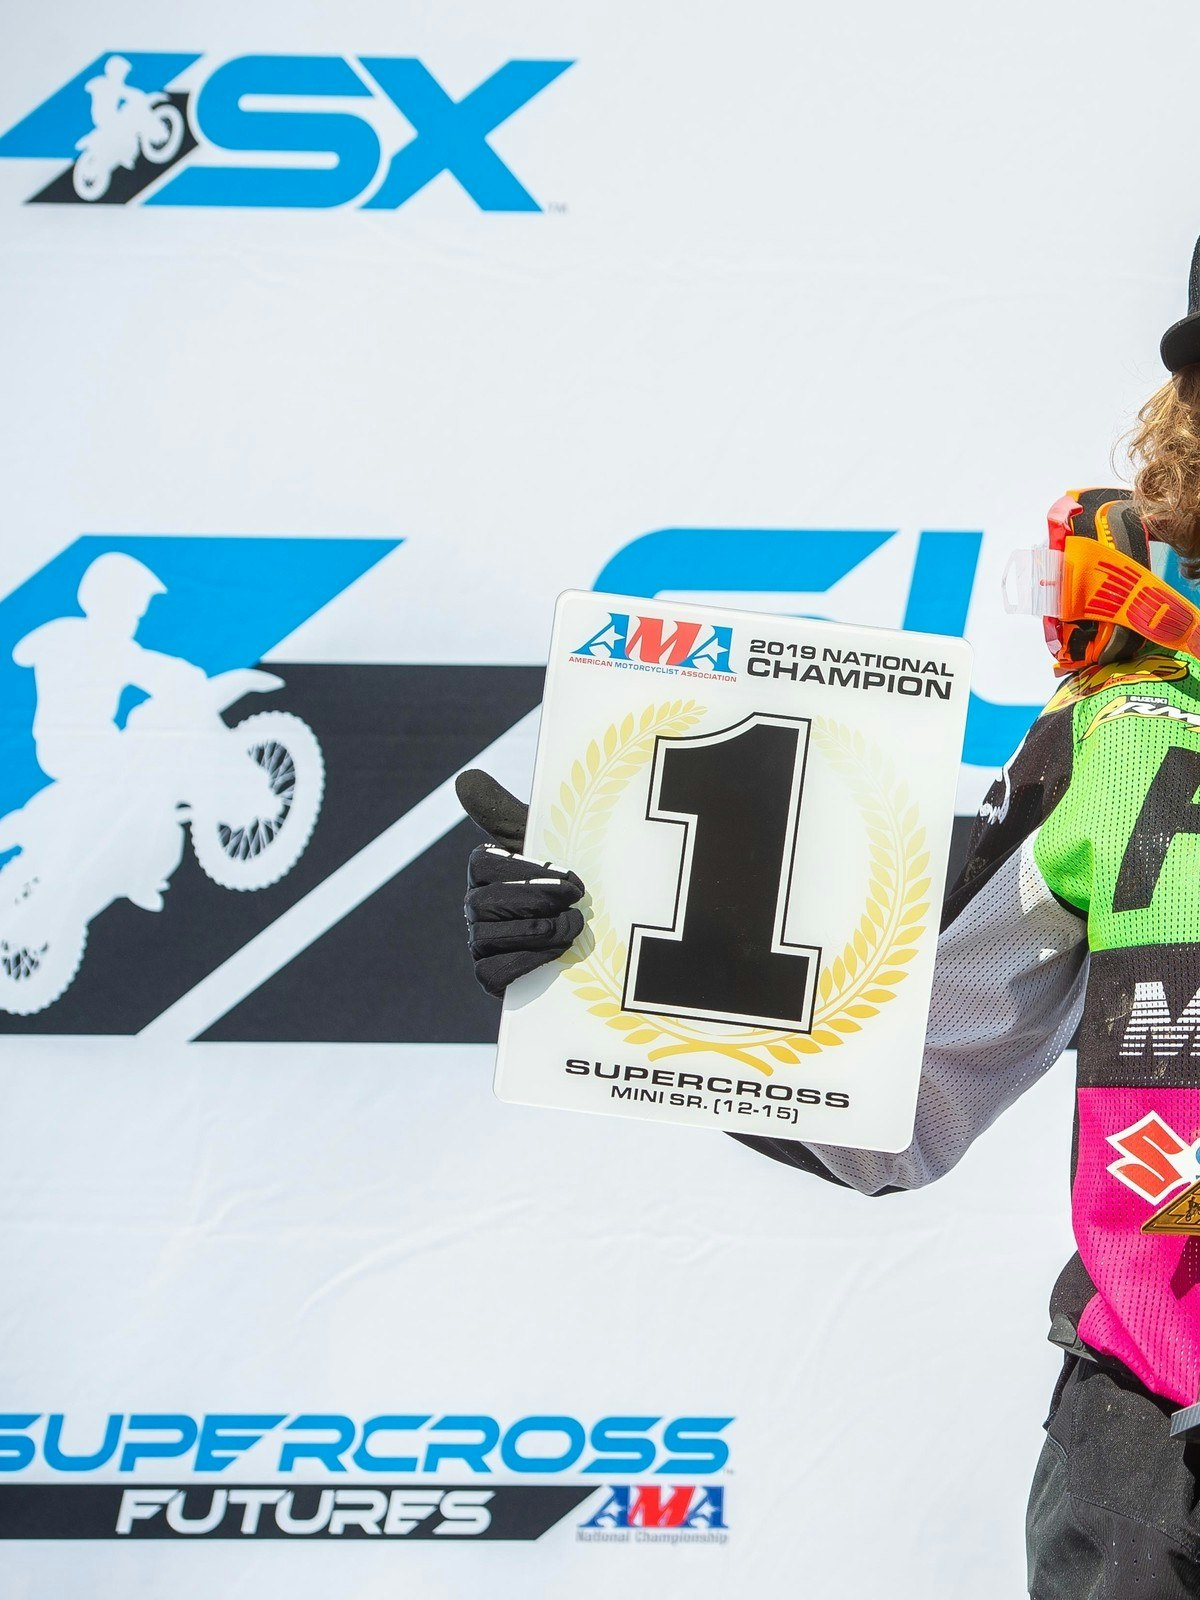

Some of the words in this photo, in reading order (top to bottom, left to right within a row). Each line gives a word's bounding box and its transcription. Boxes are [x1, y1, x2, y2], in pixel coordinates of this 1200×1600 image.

[569, 612, 738, 674] AMA
[750, 639, 816, 660] 2019
[822, 648, 954, 677] NATIONAL
[568, 656, 613, 667] AMERICAN
[614, 661, 680, 675] MOTORCYCLIST
[680, 670, 738, 682] ASSOCIATION
[747, 657, 952, 700] CHAMPION
[1130, 695, 1168, 705] SUZUKI
[621, 711, 822, 1034] 1
[565, 1058, 850, 1109] SUPERCROSS
[611, 1085, 664, 1103] MINI
[669, 1094, 708, 1110] SR.
[116, 1489, 496, 1536] FUTURES
[579, 1486, 728, 1528] AMA
[576, 1531, 629, 1543] National
[635, 1531, 728, 1545] Championship
